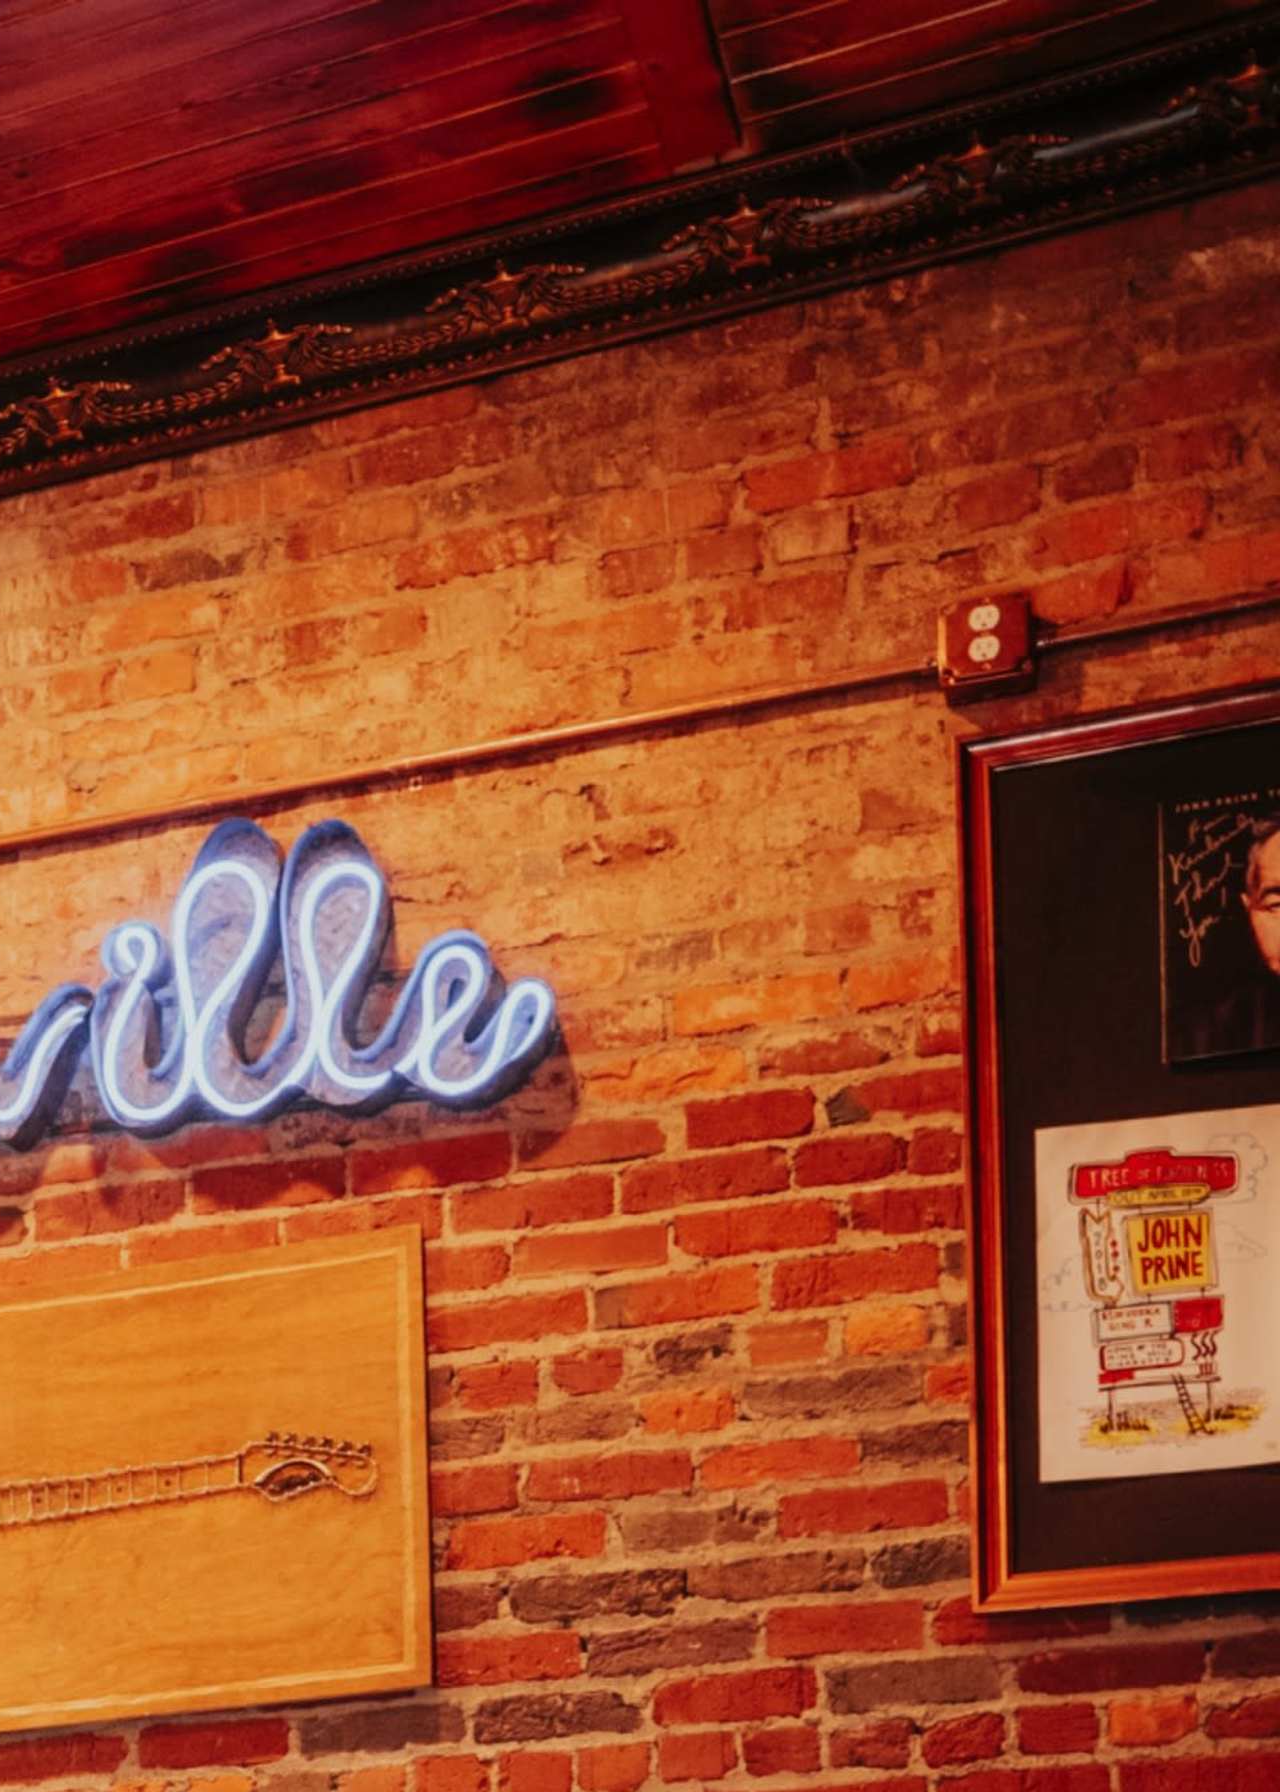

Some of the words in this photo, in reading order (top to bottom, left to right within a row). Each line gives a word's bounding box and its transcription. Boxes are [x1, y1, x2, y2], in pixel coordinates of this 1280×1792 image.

[1089, 1168, 1130, 1188] TREE
[1137, 1216, 1203, 1253] JOHN
[1139, 1250, 1203, 1286] PRINE
